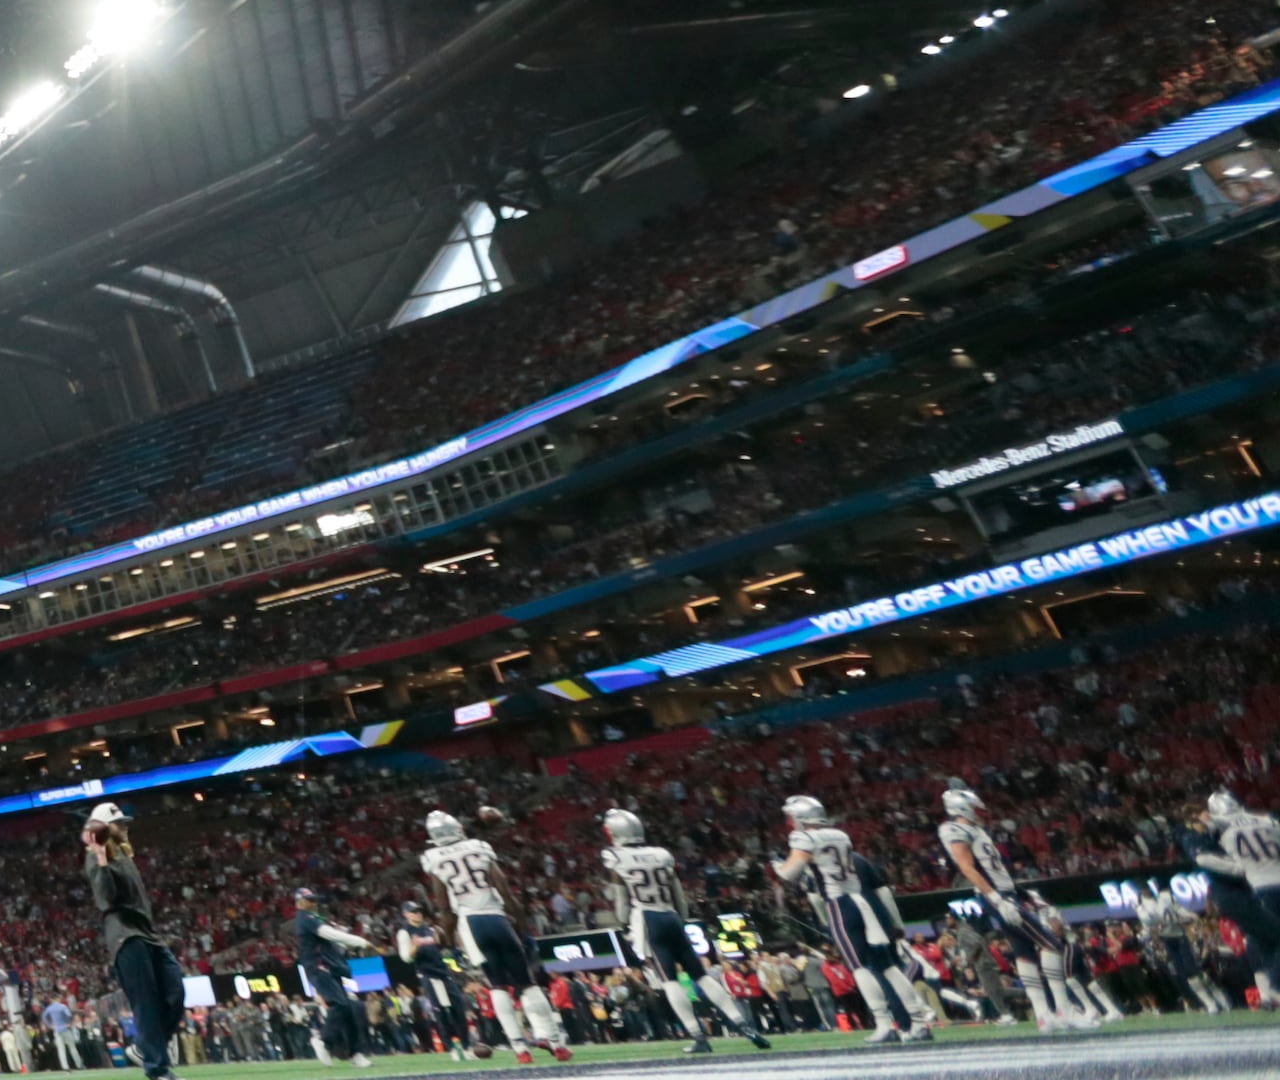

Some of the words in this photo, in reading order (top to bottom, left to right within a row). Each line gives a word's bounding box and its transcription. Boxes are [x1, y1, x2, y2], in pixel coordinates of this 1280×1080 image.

[1046, 419, 1124, 452] Stadium
[132, 526, 186, 551] YOU'RE
[186, 518, 214, 539] OFF
[213, 505, 257, 529] YOUR
[258, 492, 302, 516] GAME
[301, 479, 350, 504] WHEN
[348, 459, 410, 490] YOU'RE
[409, 437, 468, 472] HUNGRY
[809, 597, 898, 634] YOU'RE
[895, 584, 947, 612] OFF
[943, 565, 1025, 598] YOUR
[1021, 542, 1104, 579] GAME
[1098, 520, 1190, 560] WHEN
[438, 852, 489, 896] 26
[628, 868, 674, 904] 28
[1169, 872, 1210, 901] ON
[684, 924, 710, 955] 3
